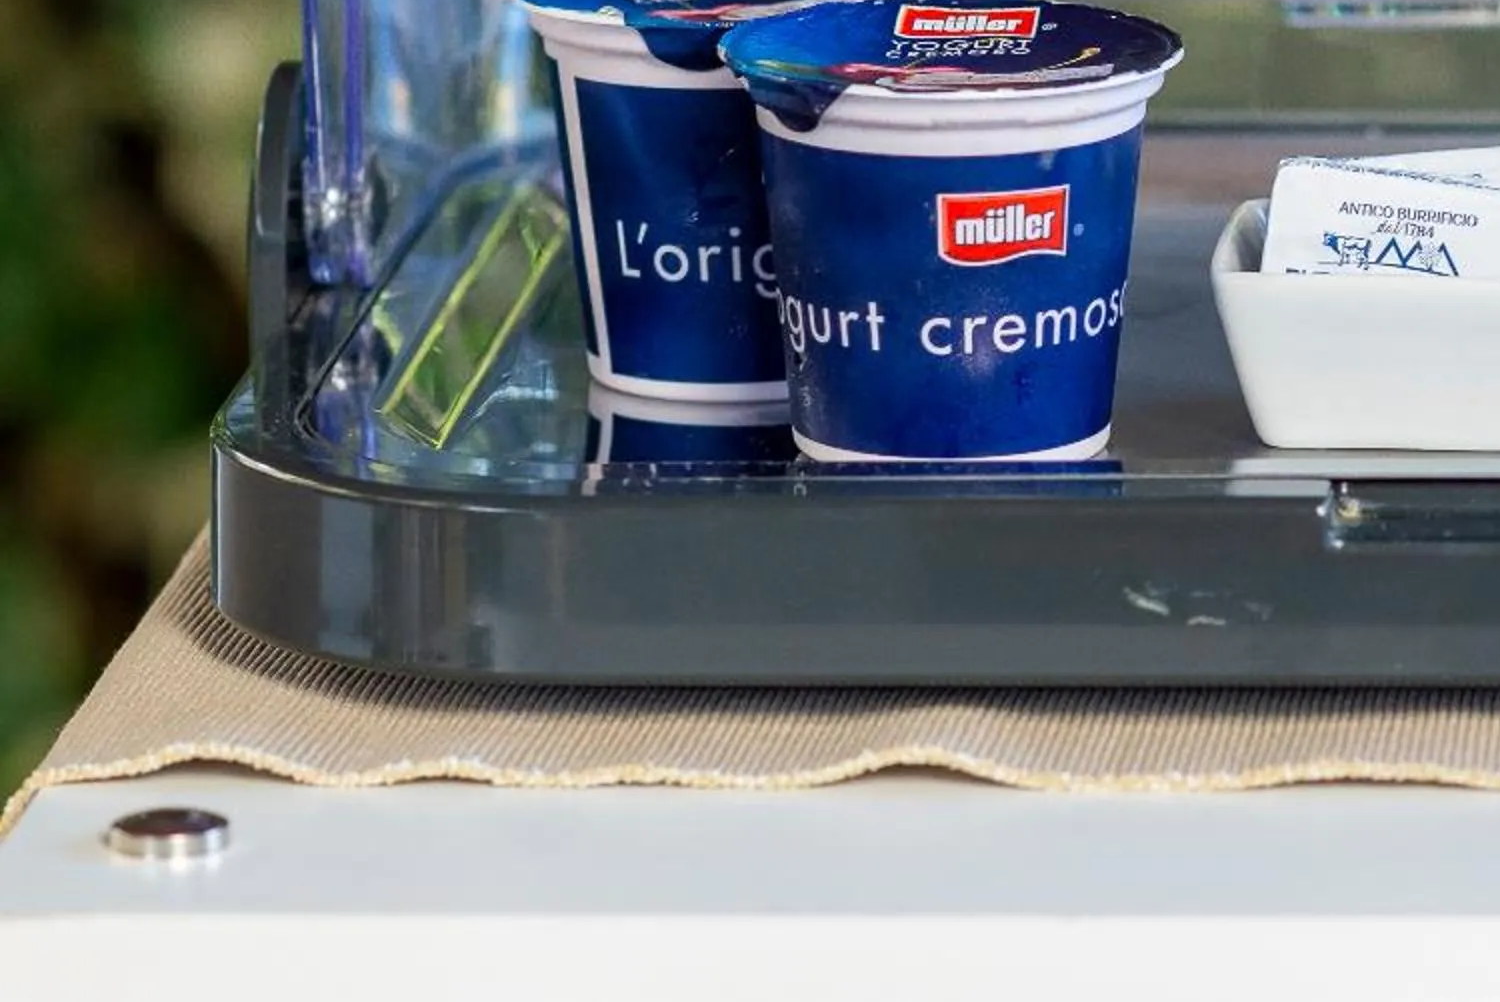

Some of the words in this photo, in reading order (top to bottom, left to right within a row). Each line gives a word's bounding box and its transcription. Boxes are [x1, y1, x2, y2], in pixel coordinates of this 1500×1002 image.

[912, 15, 1024, 33] müller
[892, 38, 1032, 51] YOGURT
[955, 204, 1055, 245] müller
[1338, 201, 1395, 219] ANTICO
[1397, 206, 1479, 227] BURRIFICIO
